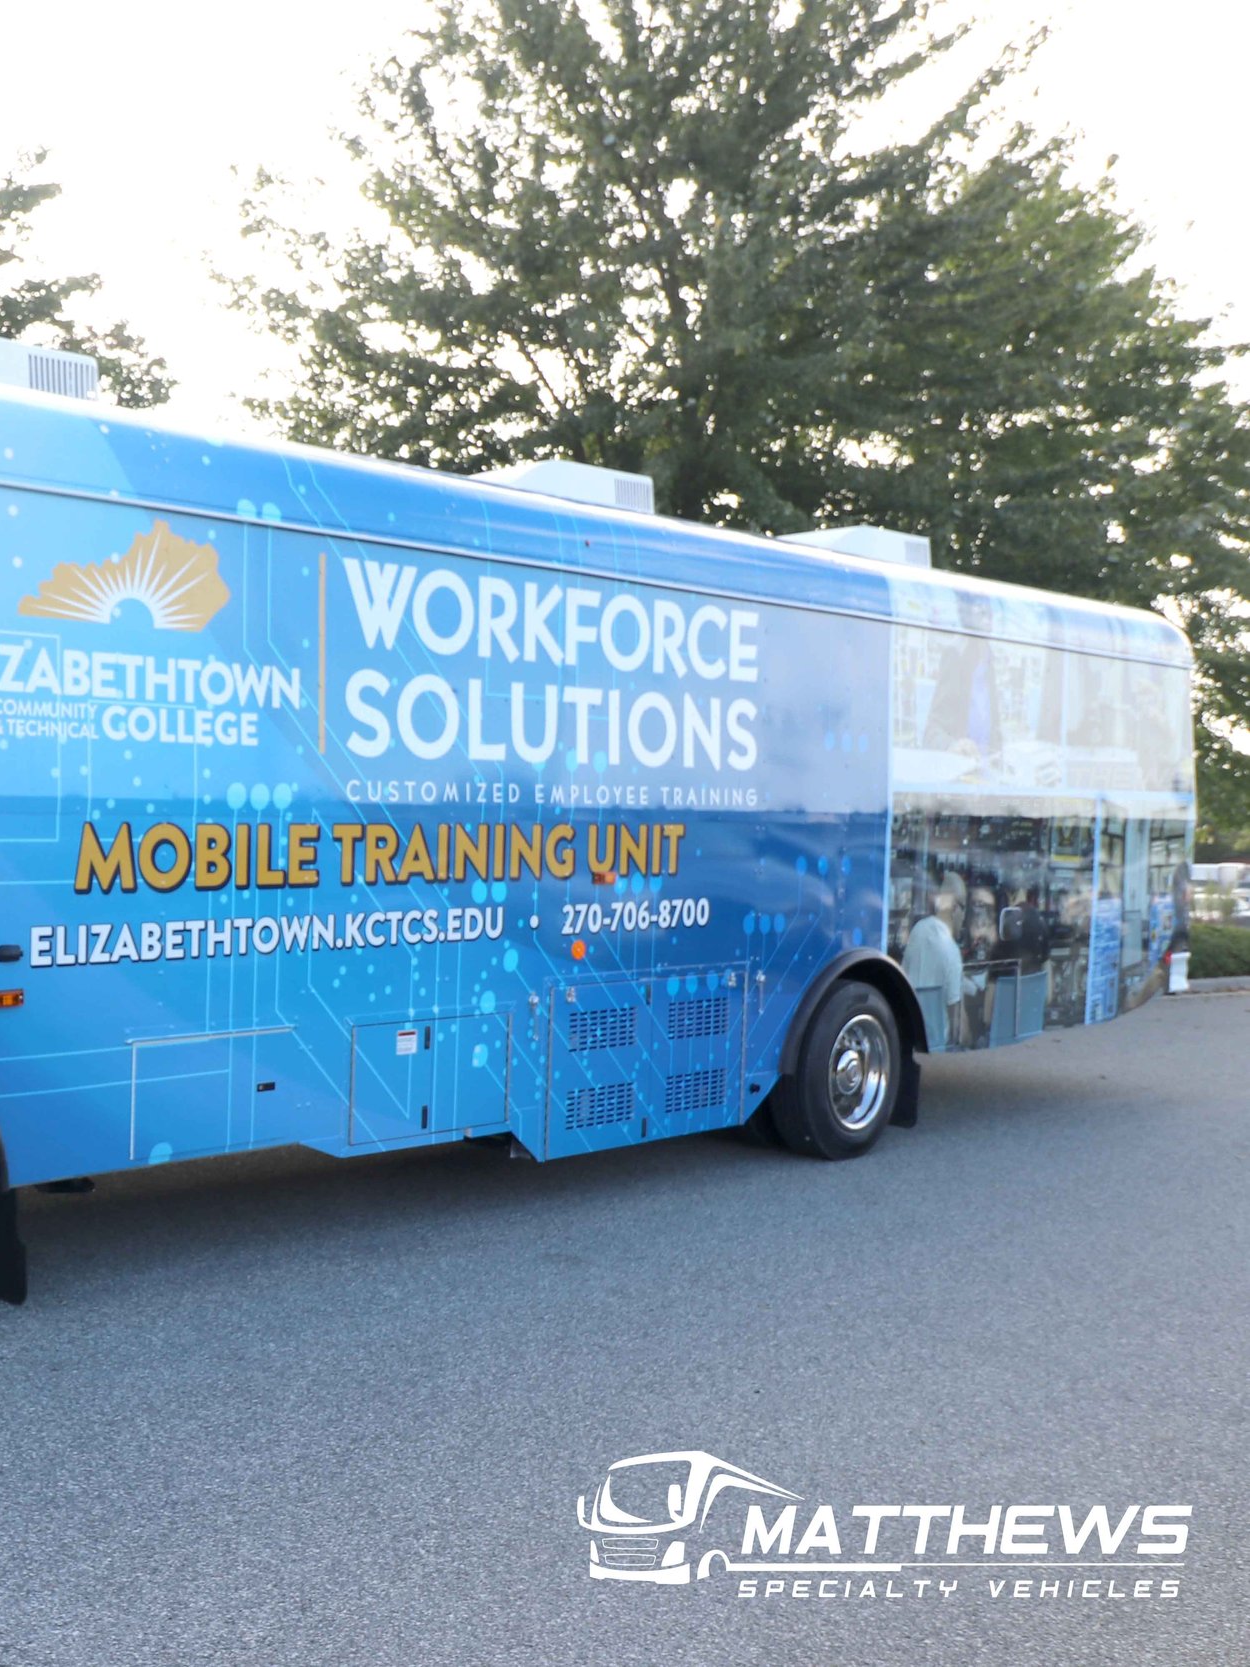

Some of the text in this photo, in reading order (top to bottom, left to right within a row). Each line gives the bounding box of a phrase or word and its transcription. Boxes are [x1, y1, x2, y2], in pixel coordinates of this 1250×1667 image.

[343, 557, 759, 682] WORKFORCE
[6, 718, 99, 739] TECHNICAL
[102, 704, 258, 746] COLLEGE
[345, 668, 758, 771] SOLUTIONS
[346, 780, 758, 806] CUSTOMIZED EMPLOYEE TRAINING
[74, 822, 685, 894] MOBILE TRAINING UNIT
[29, 898, 710, 968] ELIZABETHTOWN.KCTCS.EDU 270-706-8700
